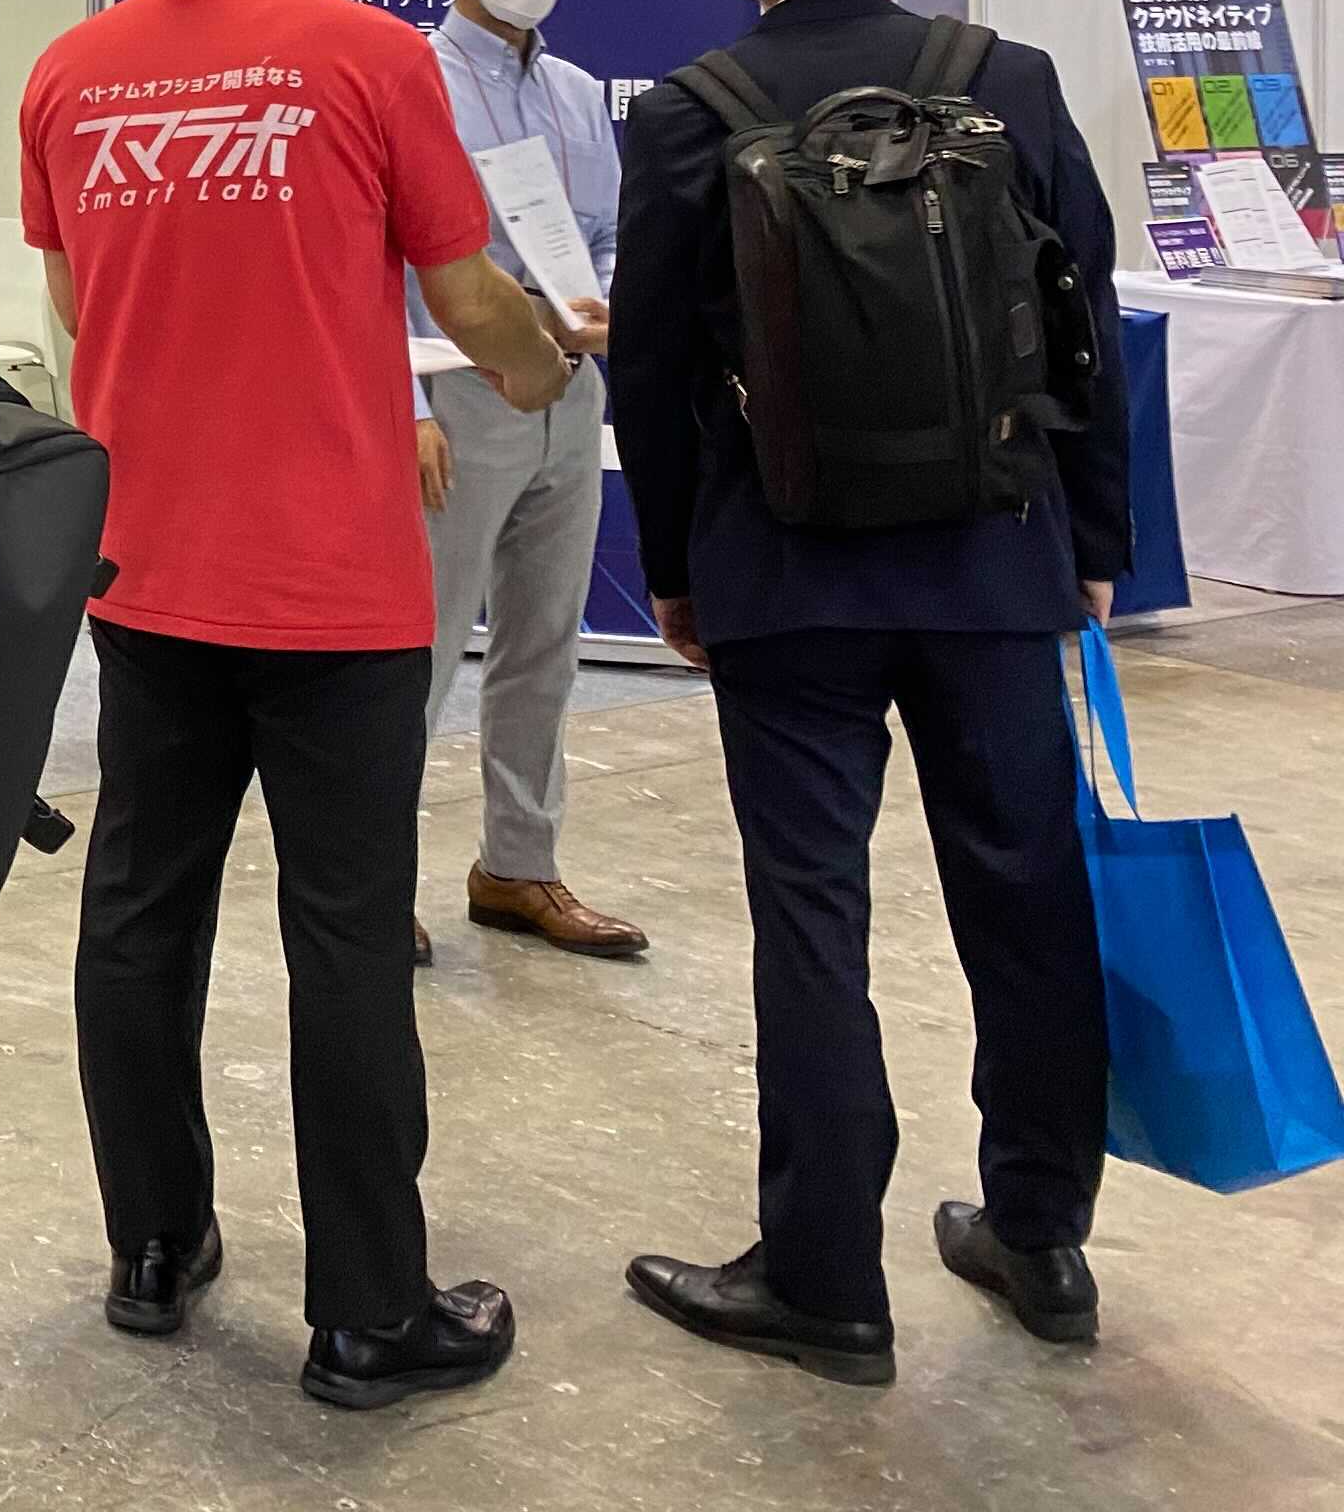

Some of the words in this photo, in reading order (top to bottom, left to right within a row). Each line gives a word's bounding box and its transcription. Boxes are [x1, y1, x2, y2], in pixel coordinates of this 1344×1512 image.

[1132, 3, 1273, 29] クラウドネイティブ
[79, 65, 304, 105] ベトナムオフショア開発なら
[73, 103, 317, 190] スマラボ
[77, 180, 176, 215] Smart
[199, 178, 294, 202] Labo
